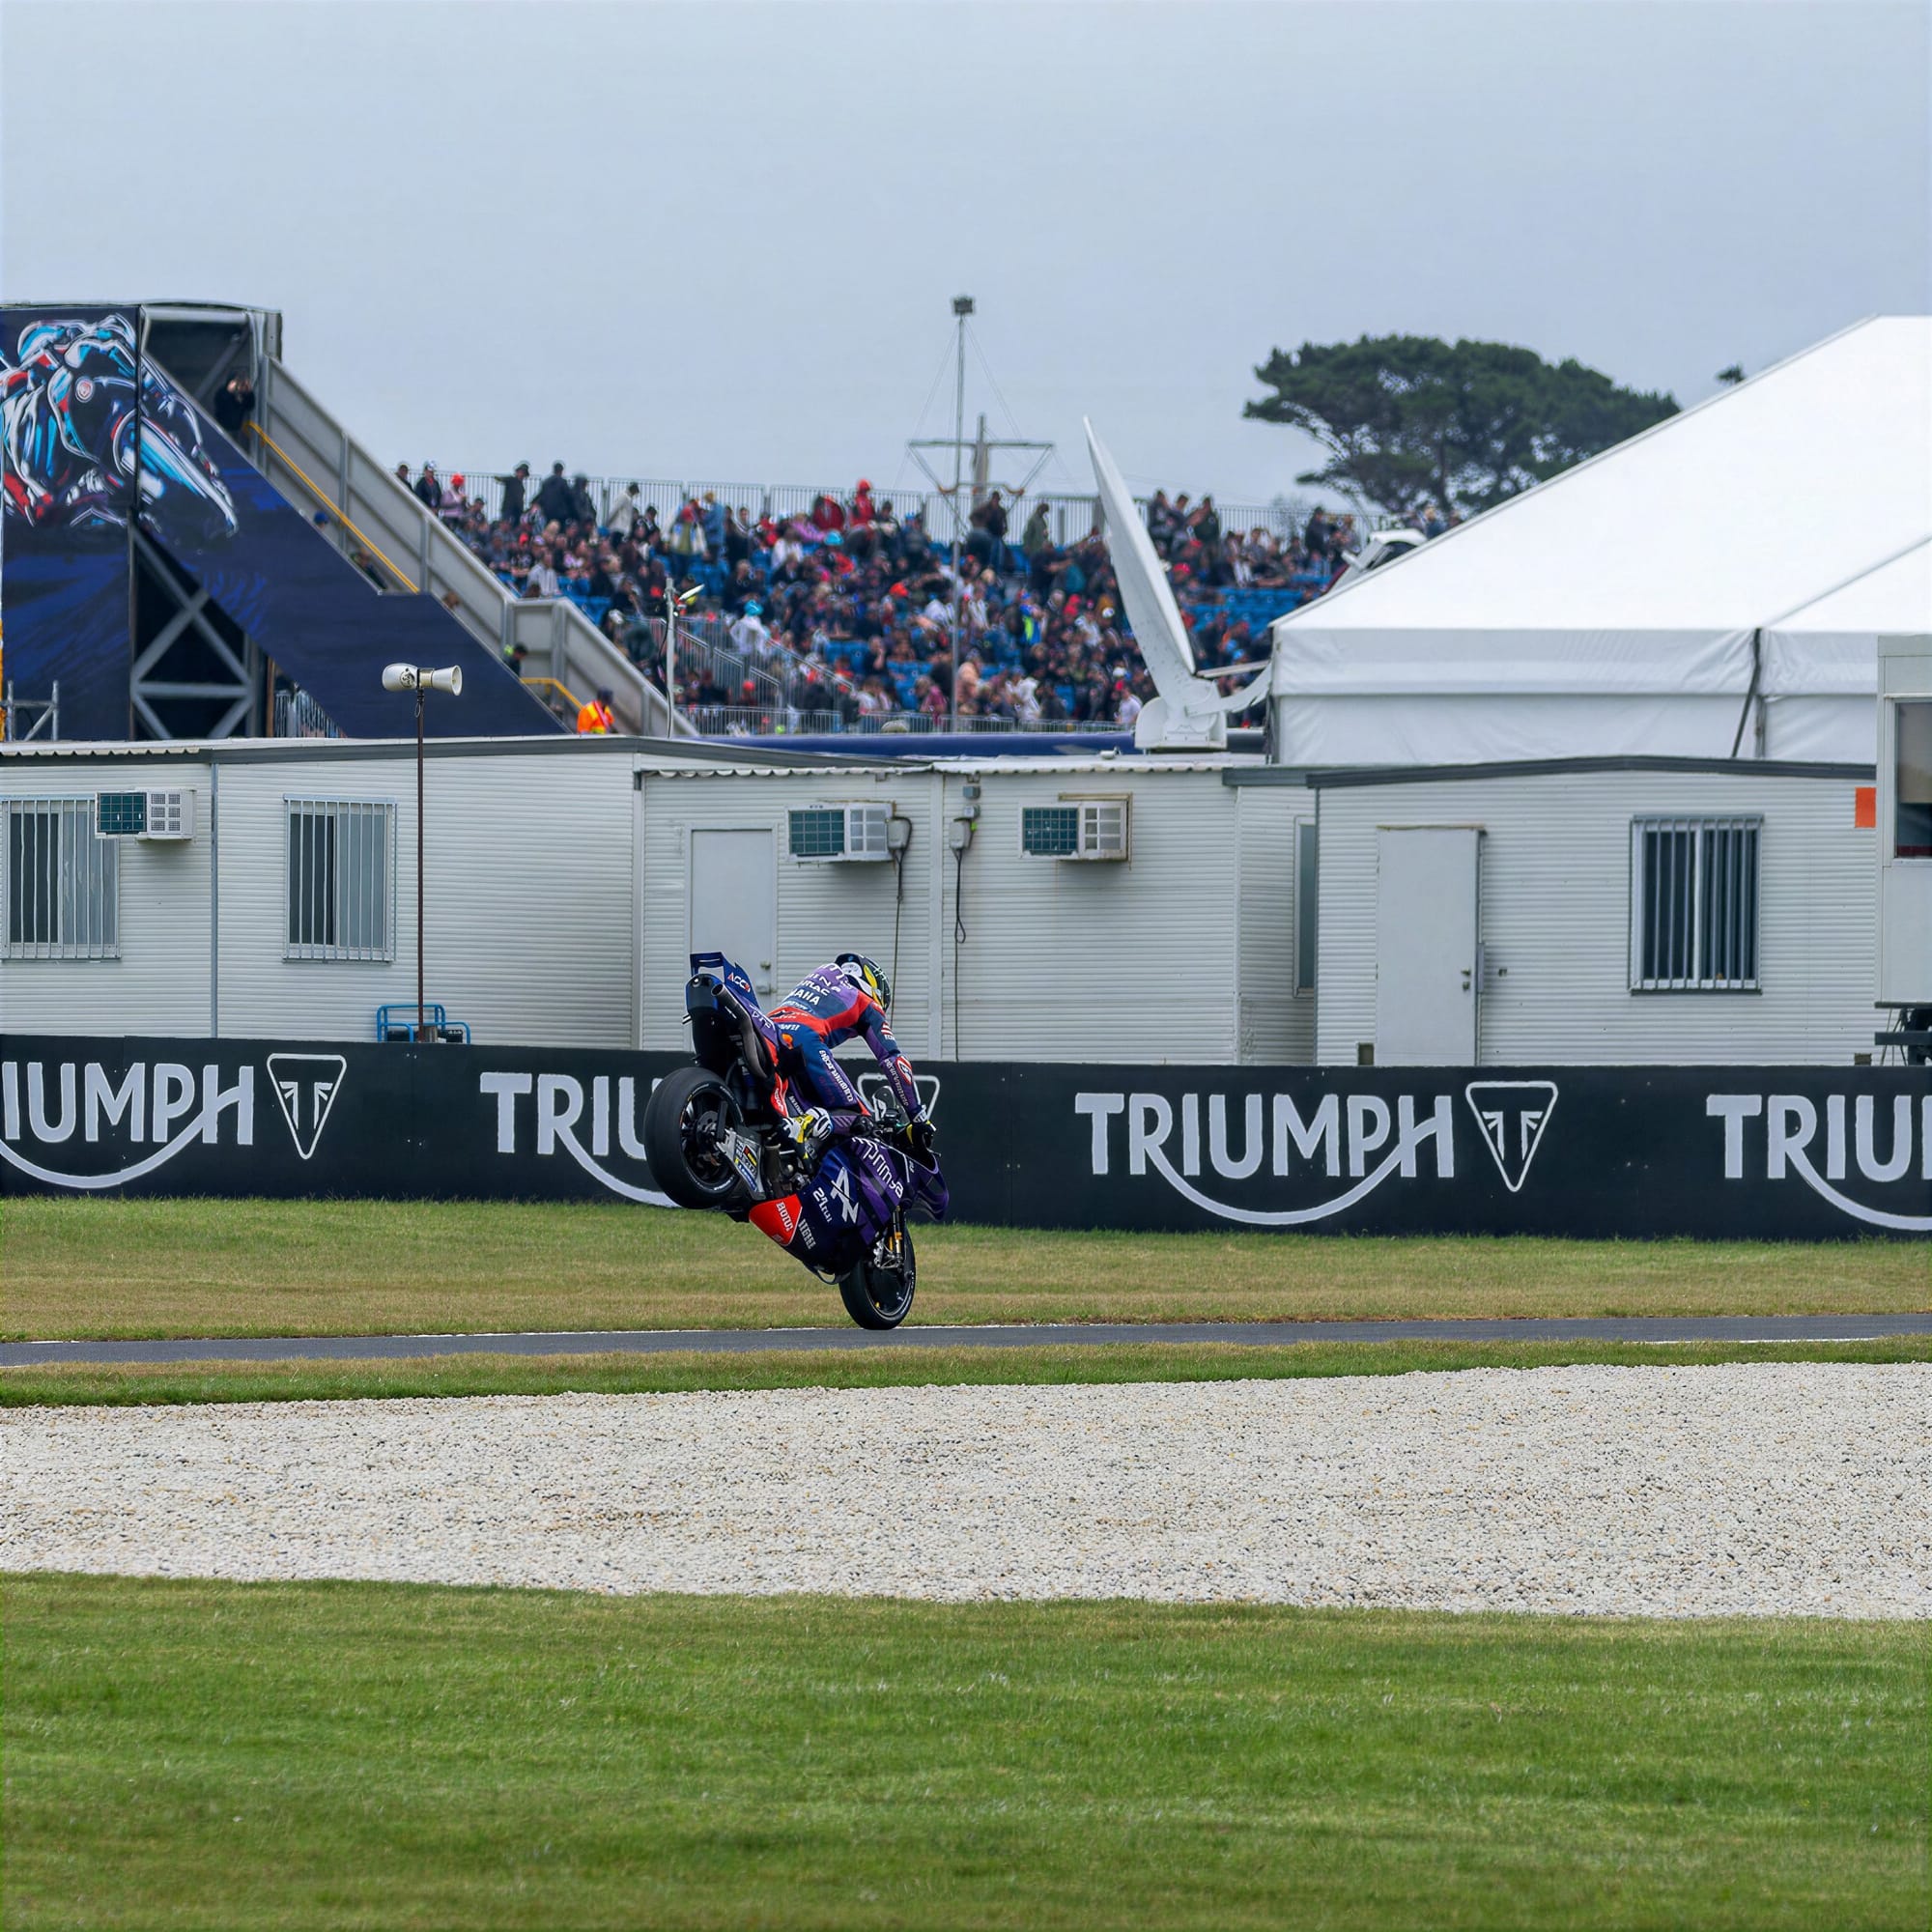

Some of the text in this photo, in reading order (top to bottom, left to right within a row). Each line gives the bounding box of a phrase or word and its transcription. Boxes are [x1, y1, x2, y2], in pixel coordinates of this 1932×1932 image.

[0, 1062, 255, 1189] IUMPH
[480, 1072, 682, 1208] TRIU
[1075, 1093, 1454, 1225] TRIUMPH
[1706, 1094, 1932, 1231] TRIU
